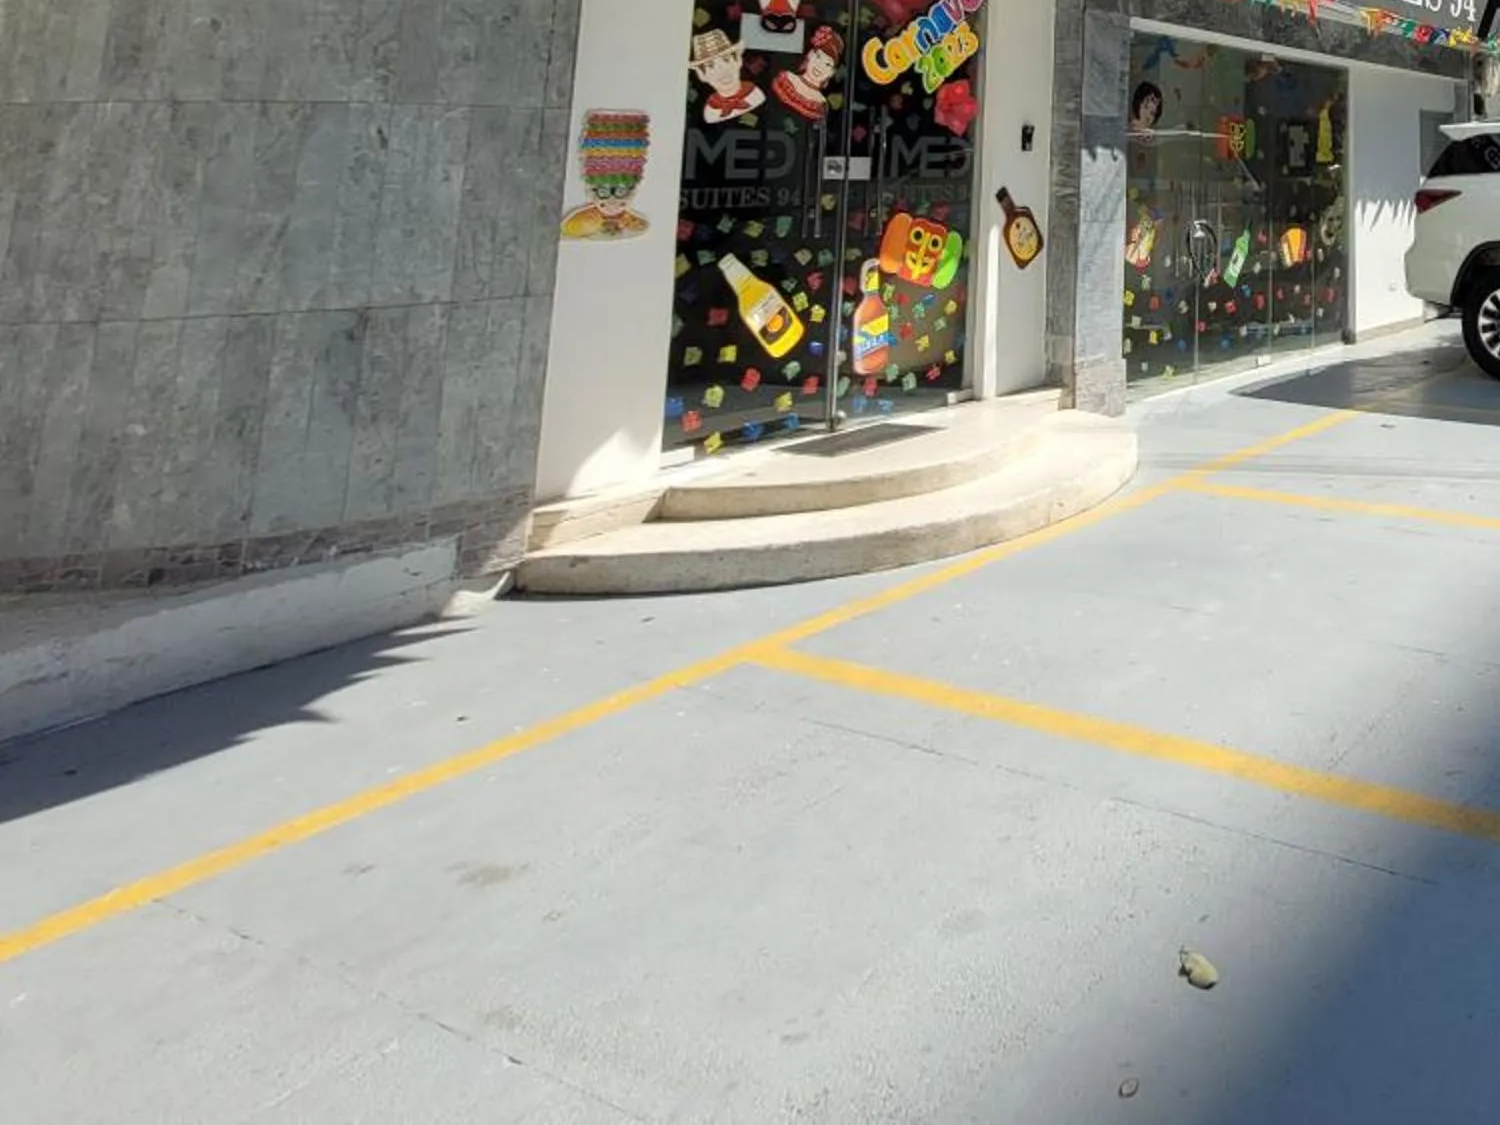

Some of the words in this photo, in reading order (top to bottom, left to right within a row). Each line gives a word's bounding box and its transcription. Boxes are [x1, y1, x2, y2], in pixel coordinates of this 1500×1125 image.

[914, 20, 979, 94] 2023
[684, 127, 796, 180] MED
[890, 134, 971, 178] MED
[680, 186, 772, 211] SUITES
[777, 187, 802, 207] 94
